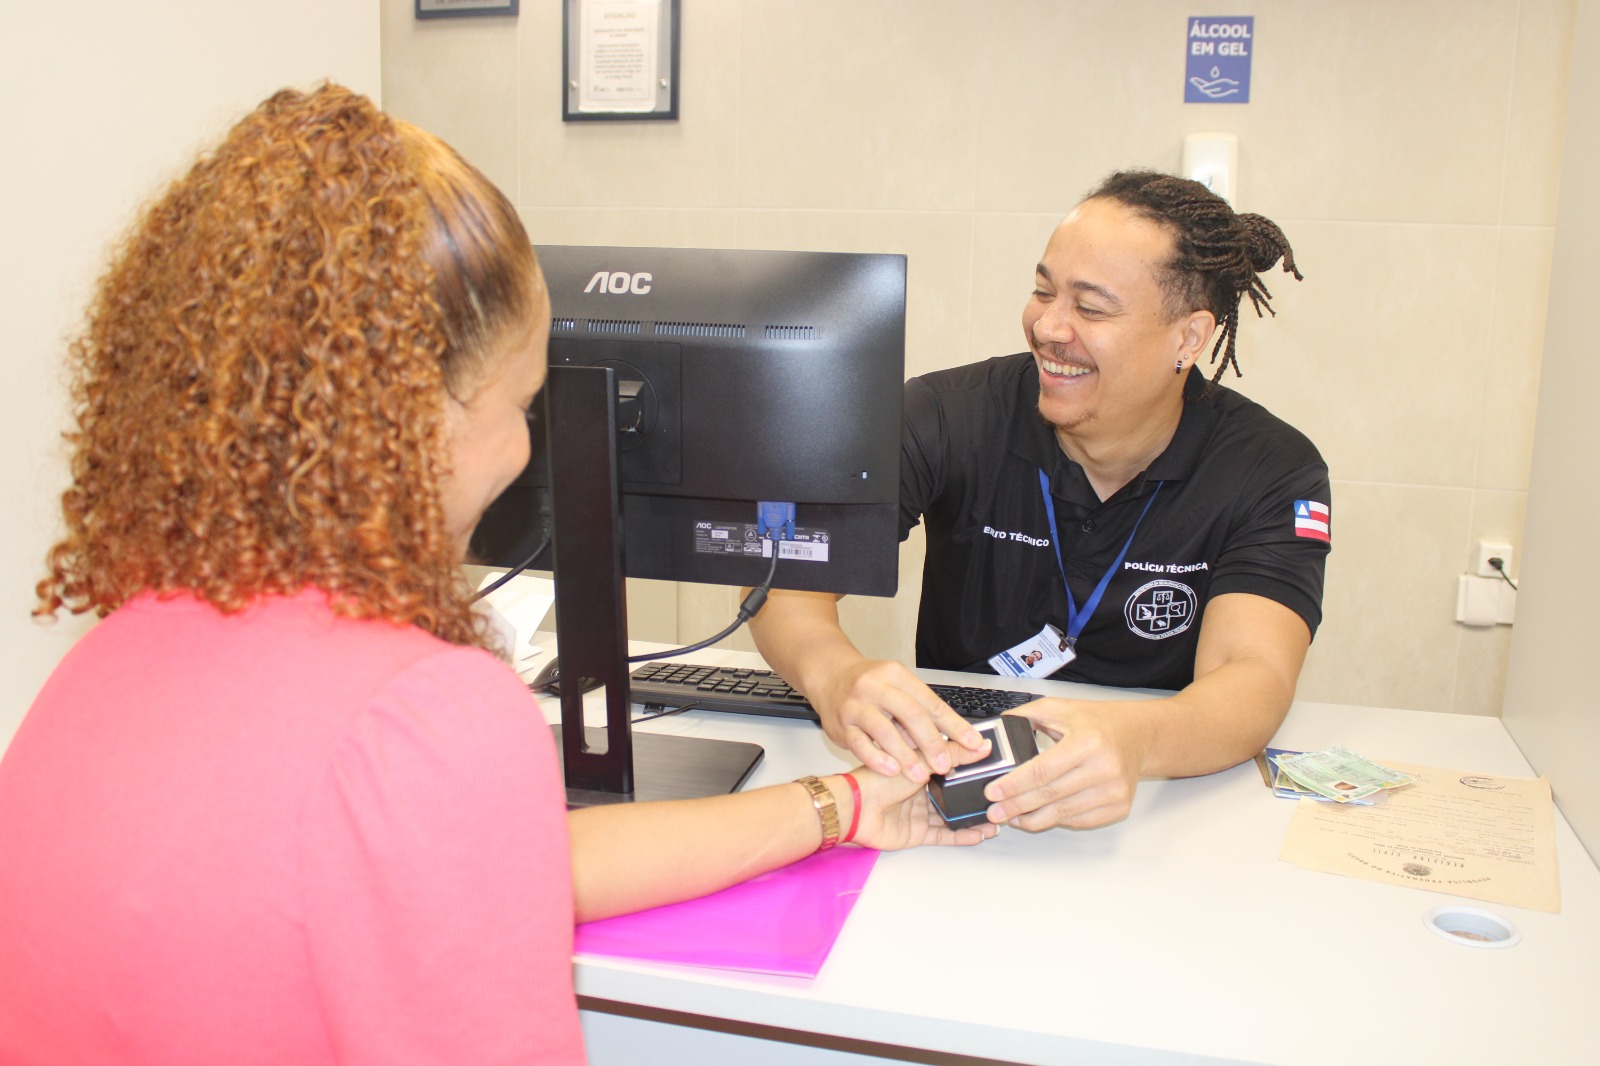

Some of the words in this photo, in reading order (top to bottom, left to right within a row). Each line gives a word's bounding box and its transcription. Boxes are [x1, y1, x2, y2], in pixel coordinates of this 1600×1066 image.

[1190, 19, 1252, 38] ÁLCOOL
[1191, 41, 1215, 56] EM
[1218, 41, 1248, 56] GEL
[583, 271, 653, 295] AOC
[1009, 532, 1050, 547] TÉCNICO
[1124, 562, 1164, 573] POLÍCIA
[1166, 562, 1209, 574] TÉCNICA
